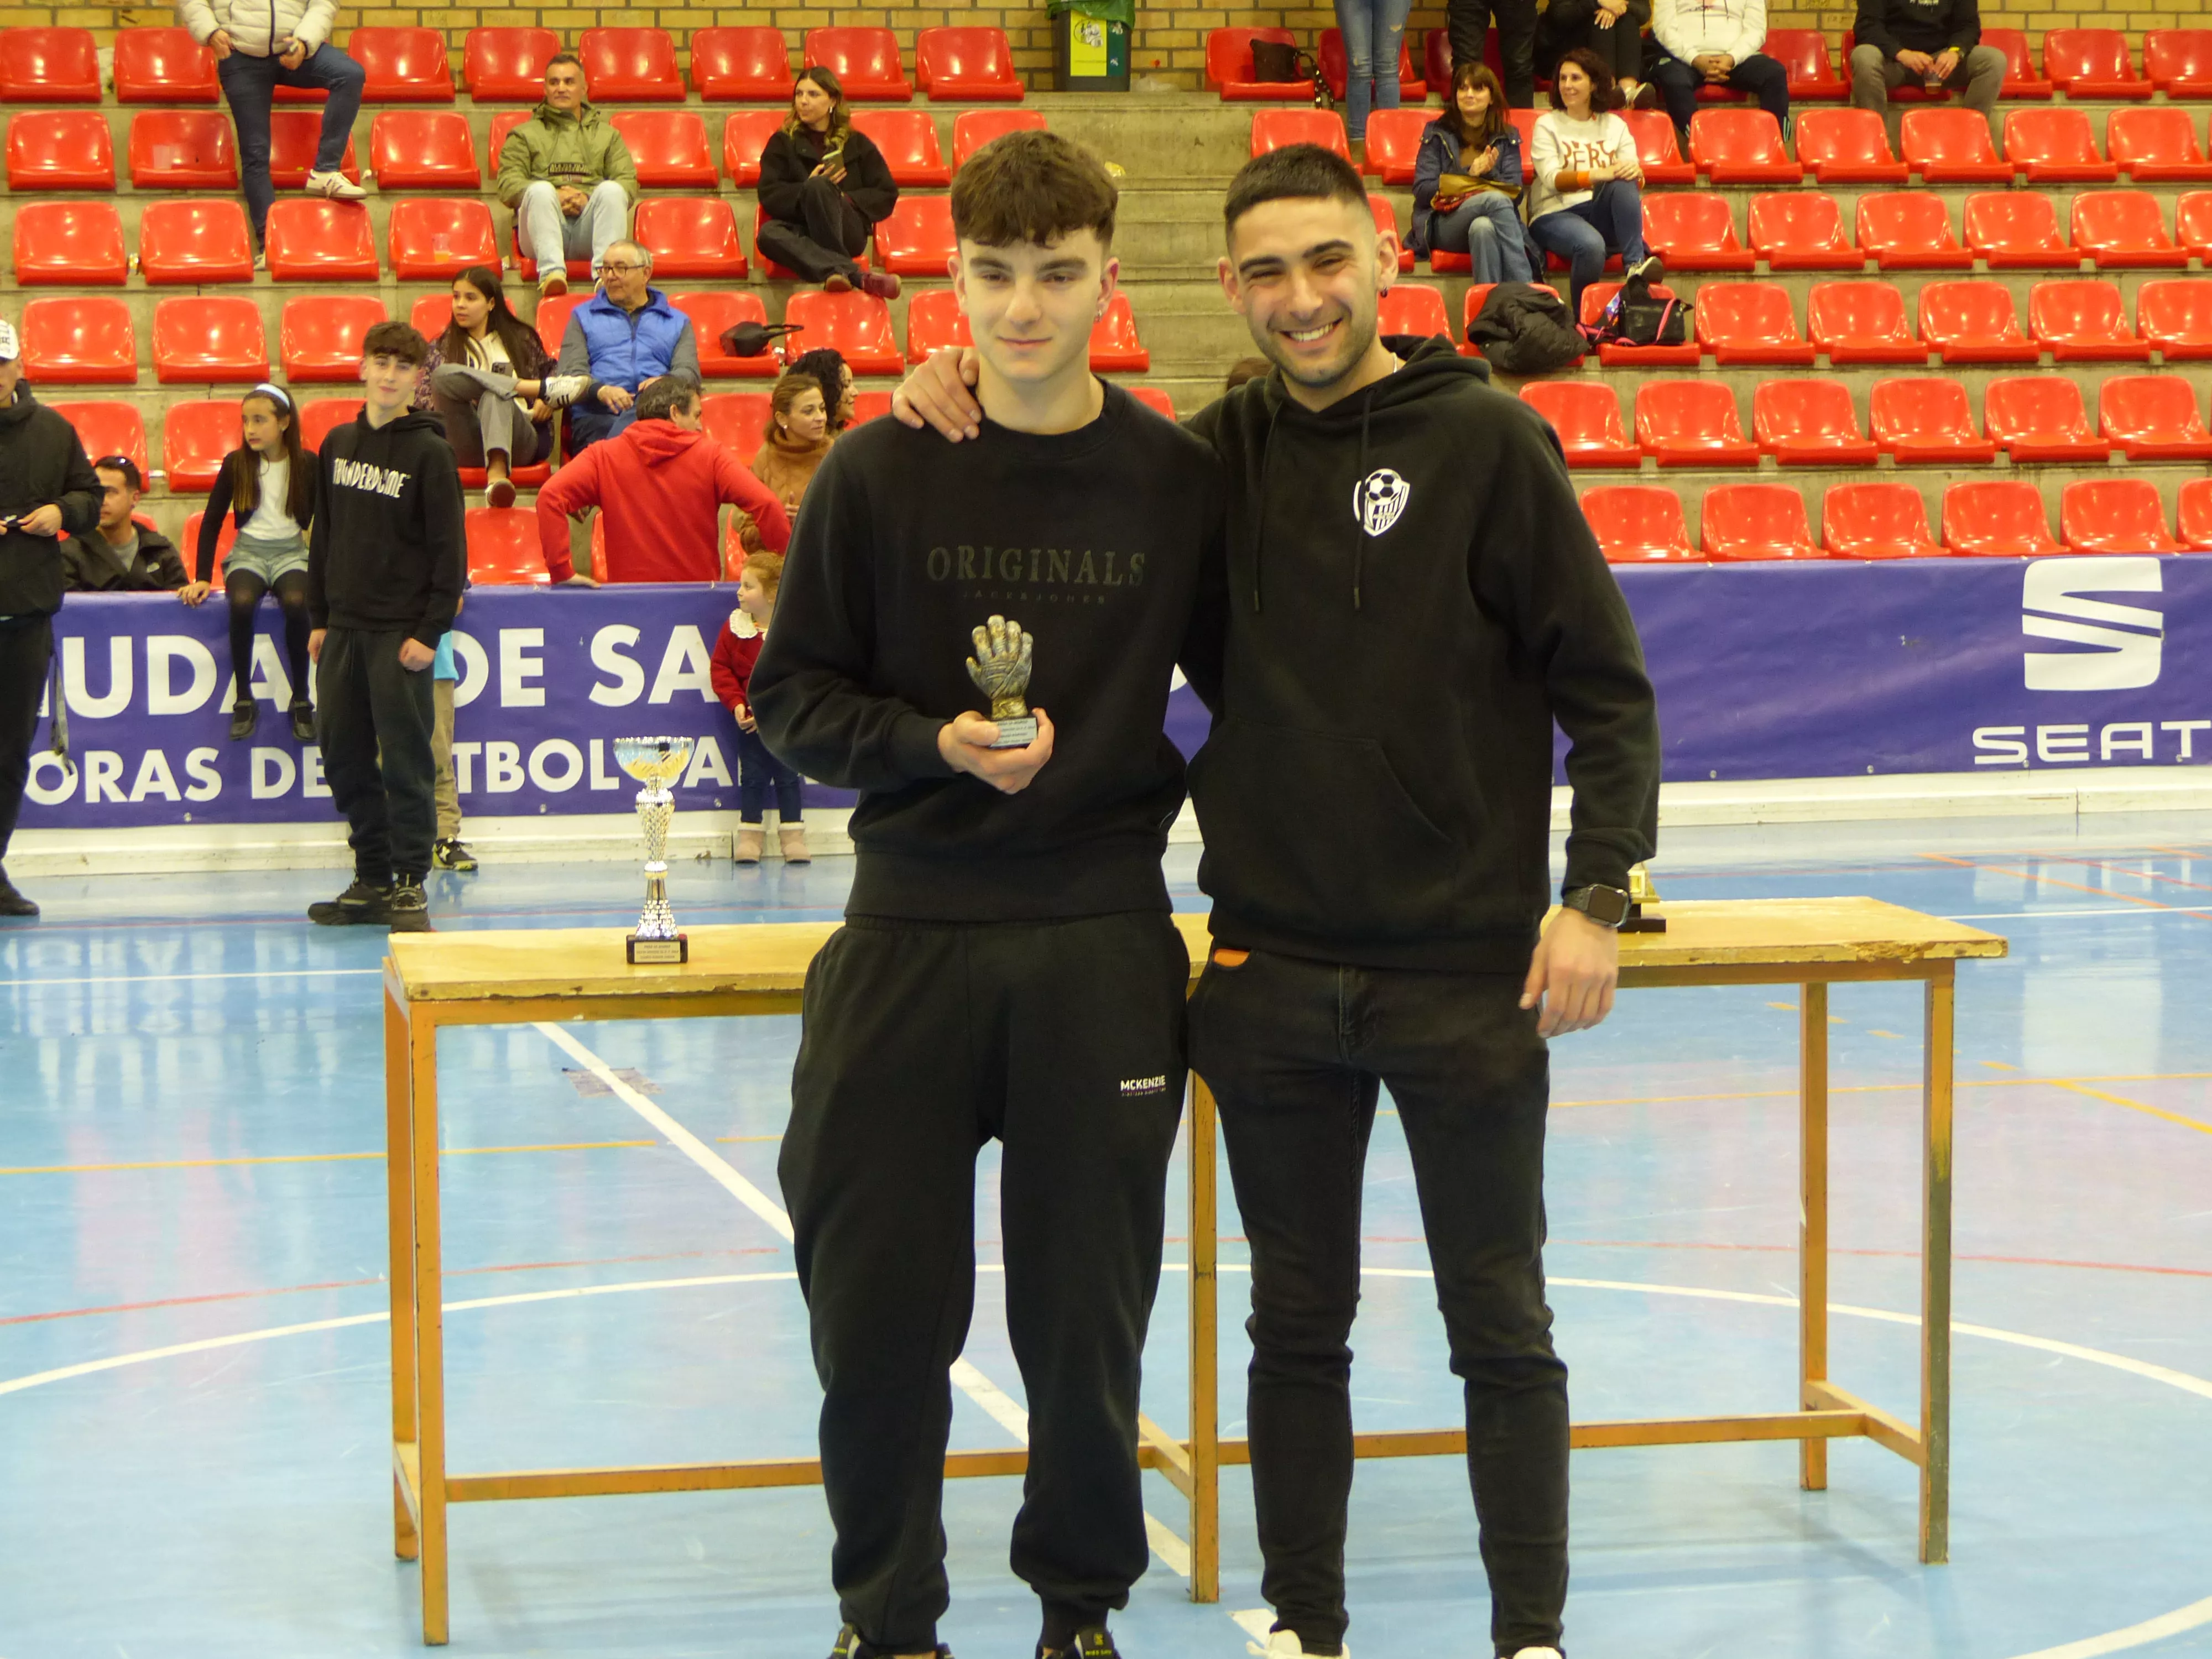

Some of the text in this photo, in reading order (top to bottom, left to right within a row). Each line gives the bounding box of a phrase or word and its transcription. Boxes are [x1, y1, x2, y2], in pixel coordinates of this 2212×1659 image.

[926, 545, 1145, 587] ORIGINALS
[589, 624, 721, 707] SA
[1973, 720, 2211, 764] SEAT
[24, 747, 222, 806] ORAS
[451, 739, 619, 793] TBOL
[1120, 1074, 1166, 1091] MCKENZIE
